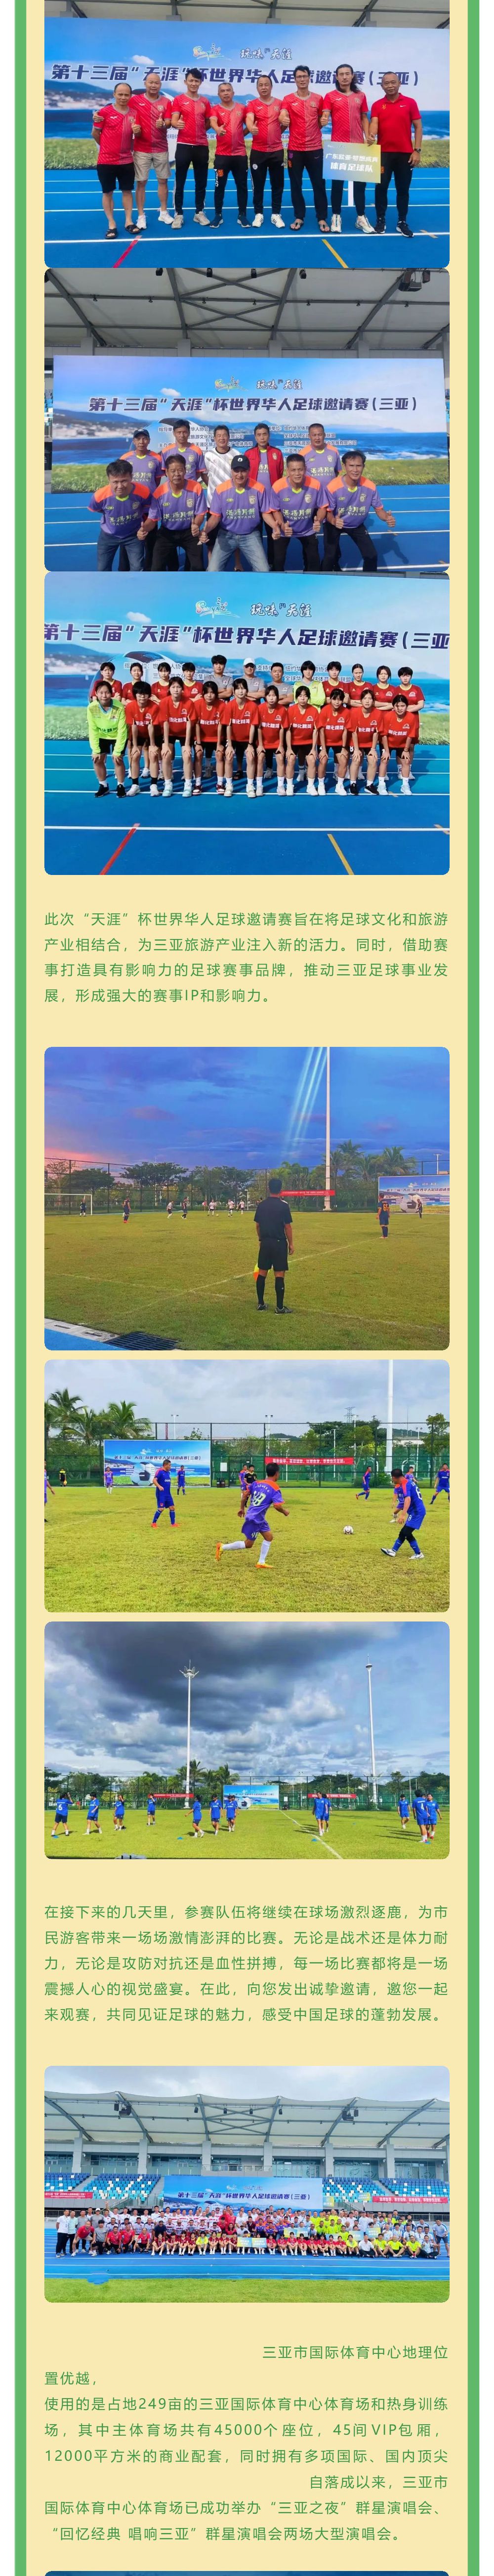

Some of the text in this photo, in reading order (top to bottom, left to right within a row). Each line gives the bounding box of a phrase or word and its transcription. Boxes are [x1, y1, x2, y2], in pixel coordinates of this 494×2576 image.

[330, 162, 373, 172] 体育足球队
